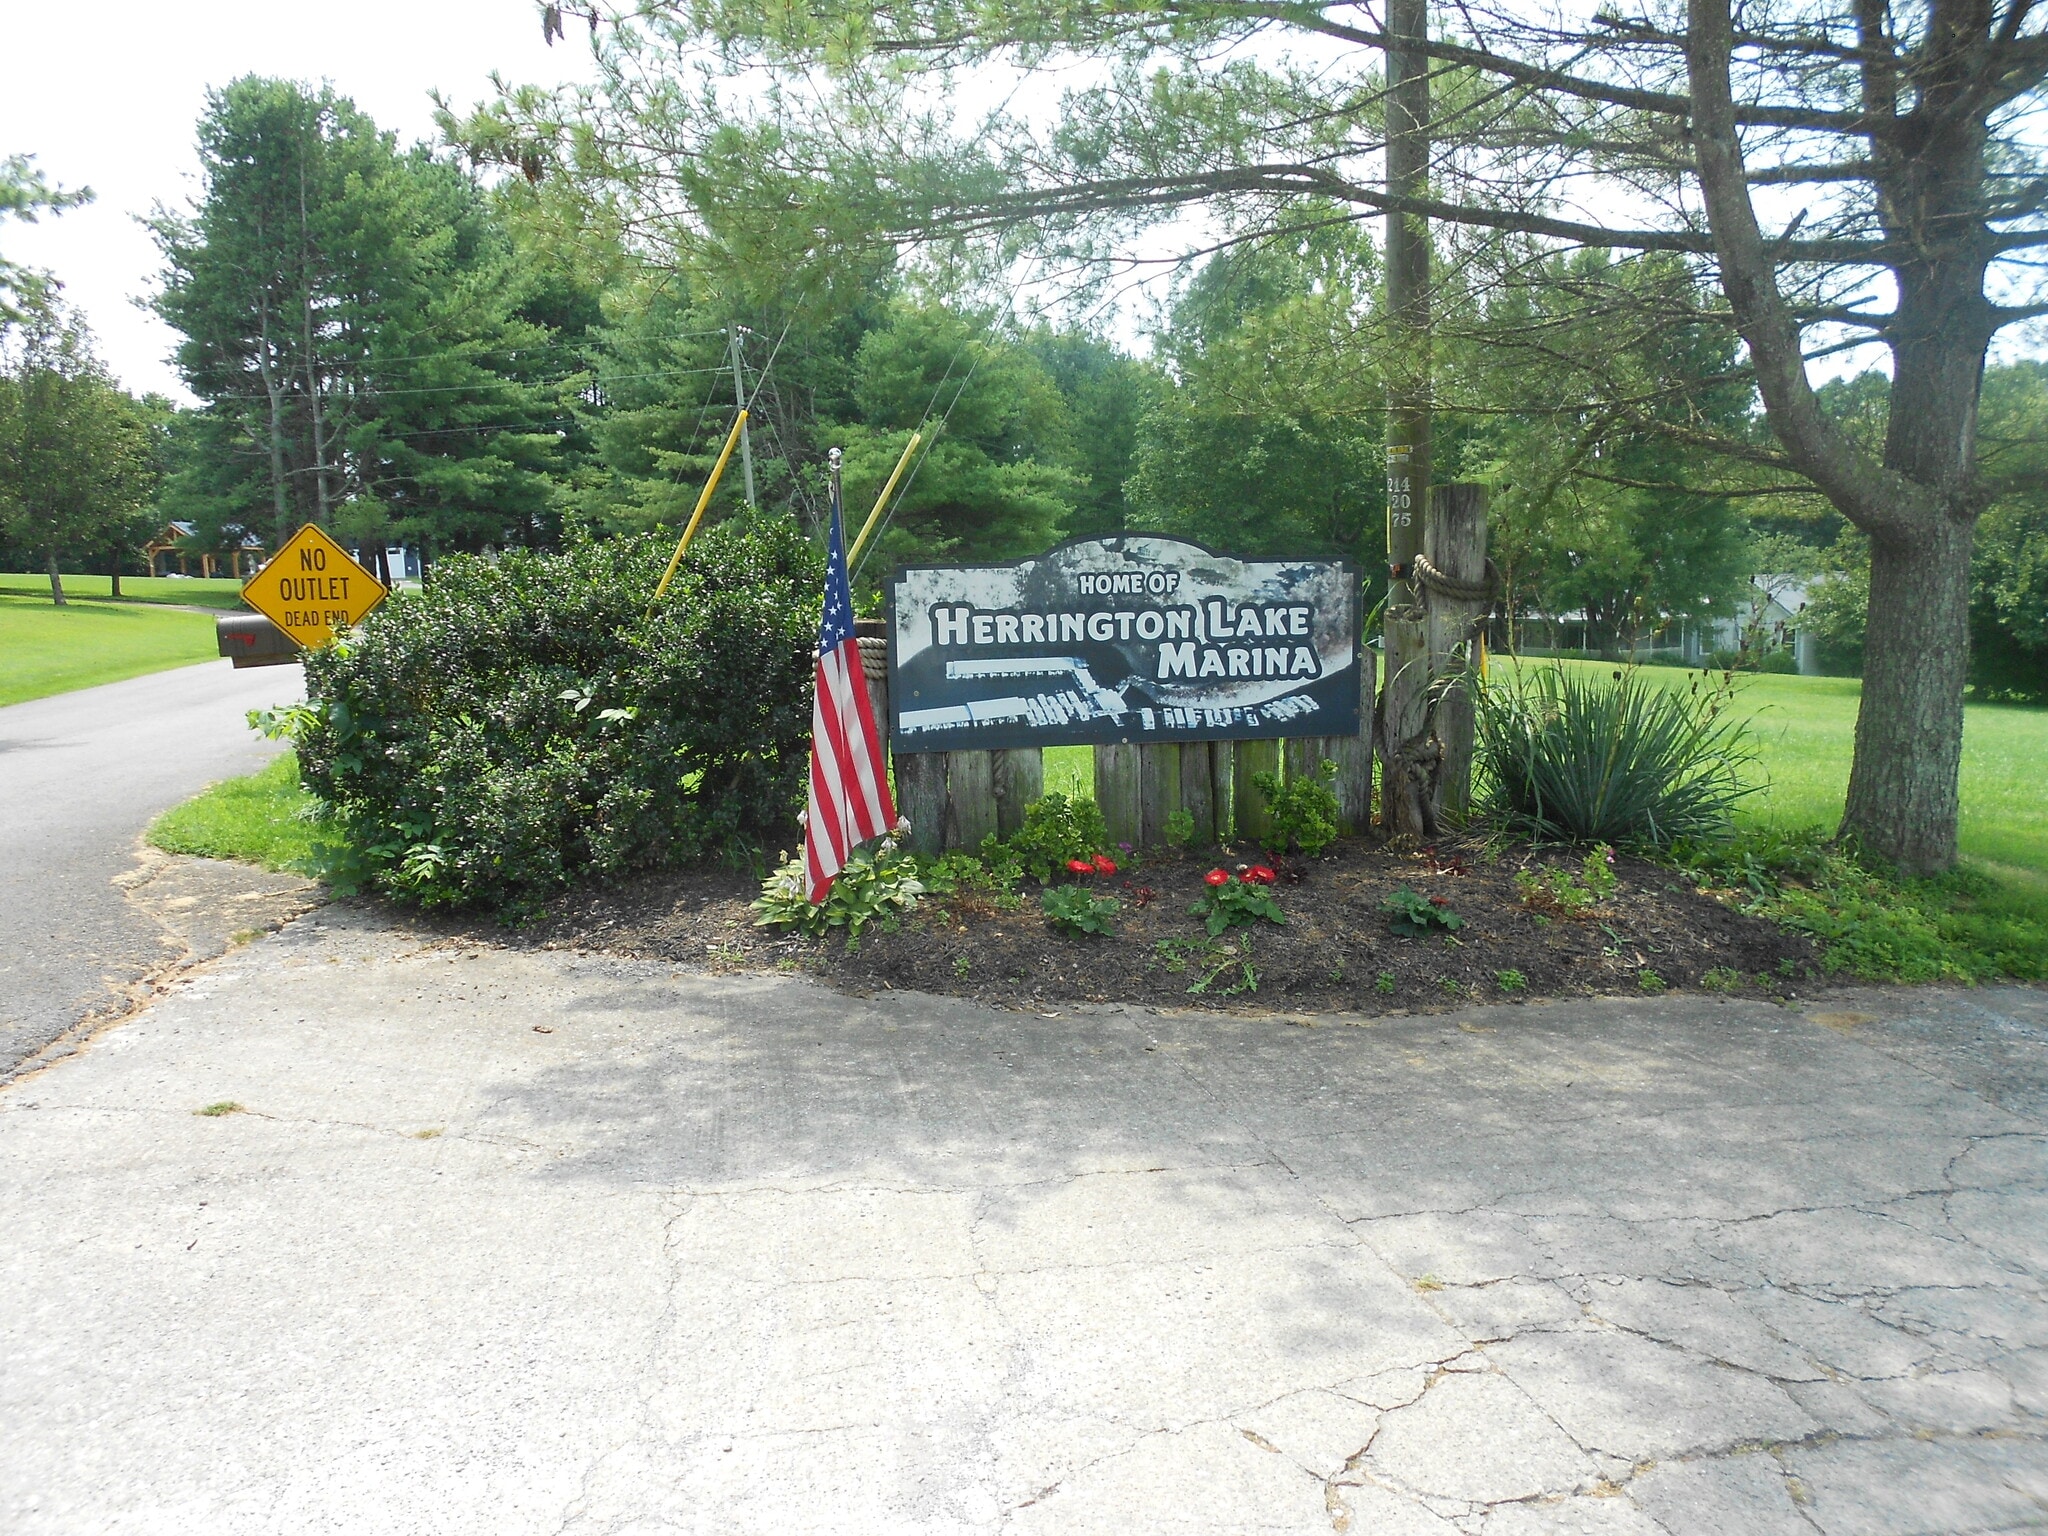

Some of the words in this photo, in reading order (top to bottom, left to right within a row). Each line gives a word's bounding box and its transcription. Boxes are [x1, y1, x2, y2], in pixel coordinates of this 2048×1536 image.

[1387, 477, 1411, 493] 214
[1391, 494, 1411, 509] 20
[1391, 512, 1412, 527] 75
[300, 548, 326, 571] NO
[280, 577, 349, 601] OUTLET
[1079, 574, 1142, 595] HOME
[1149, 573, 1179, 593] OF
[285, 610, 319, 627] DEAD
[324, 609, 349, 626] END
[934, 607, 1191, 646] HERRINGTON
[1208, 600, 1309, 639] LAKE
[1157, 641, 1318, 679] MARINA
